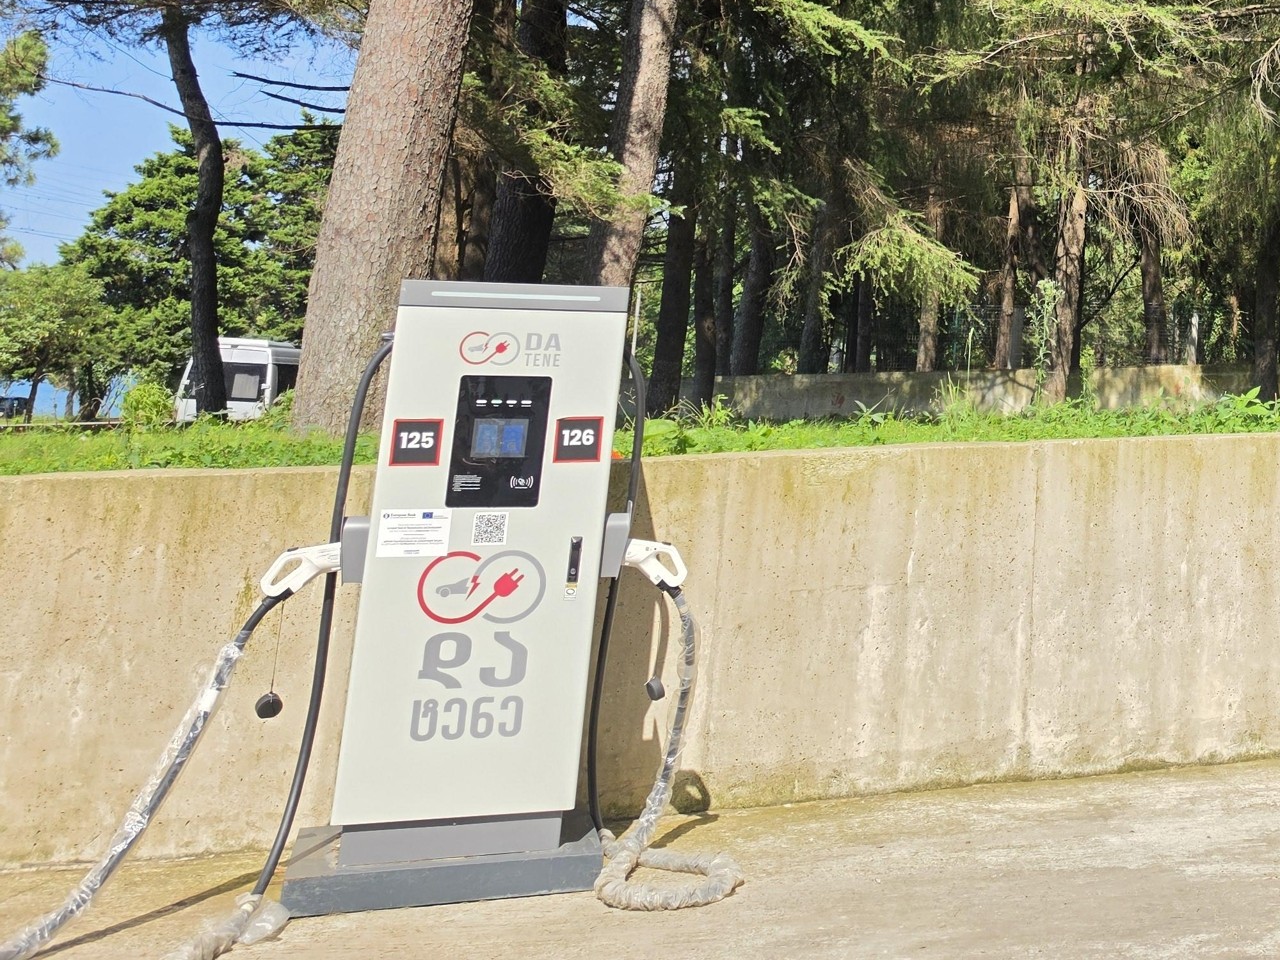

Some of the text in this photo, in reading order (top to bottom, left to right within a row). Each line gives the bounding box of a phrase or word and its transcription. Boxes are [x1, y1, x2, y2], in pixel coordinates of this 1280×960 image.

[525, 333, 562, 352] DA
[525, 353, 560, 367] TENE
[399, 431, 435, 449] 125
[561, 429, 594, 446] 126
[417, 631, 529, 689] და
[409, 695, 524, 742] ტენე
